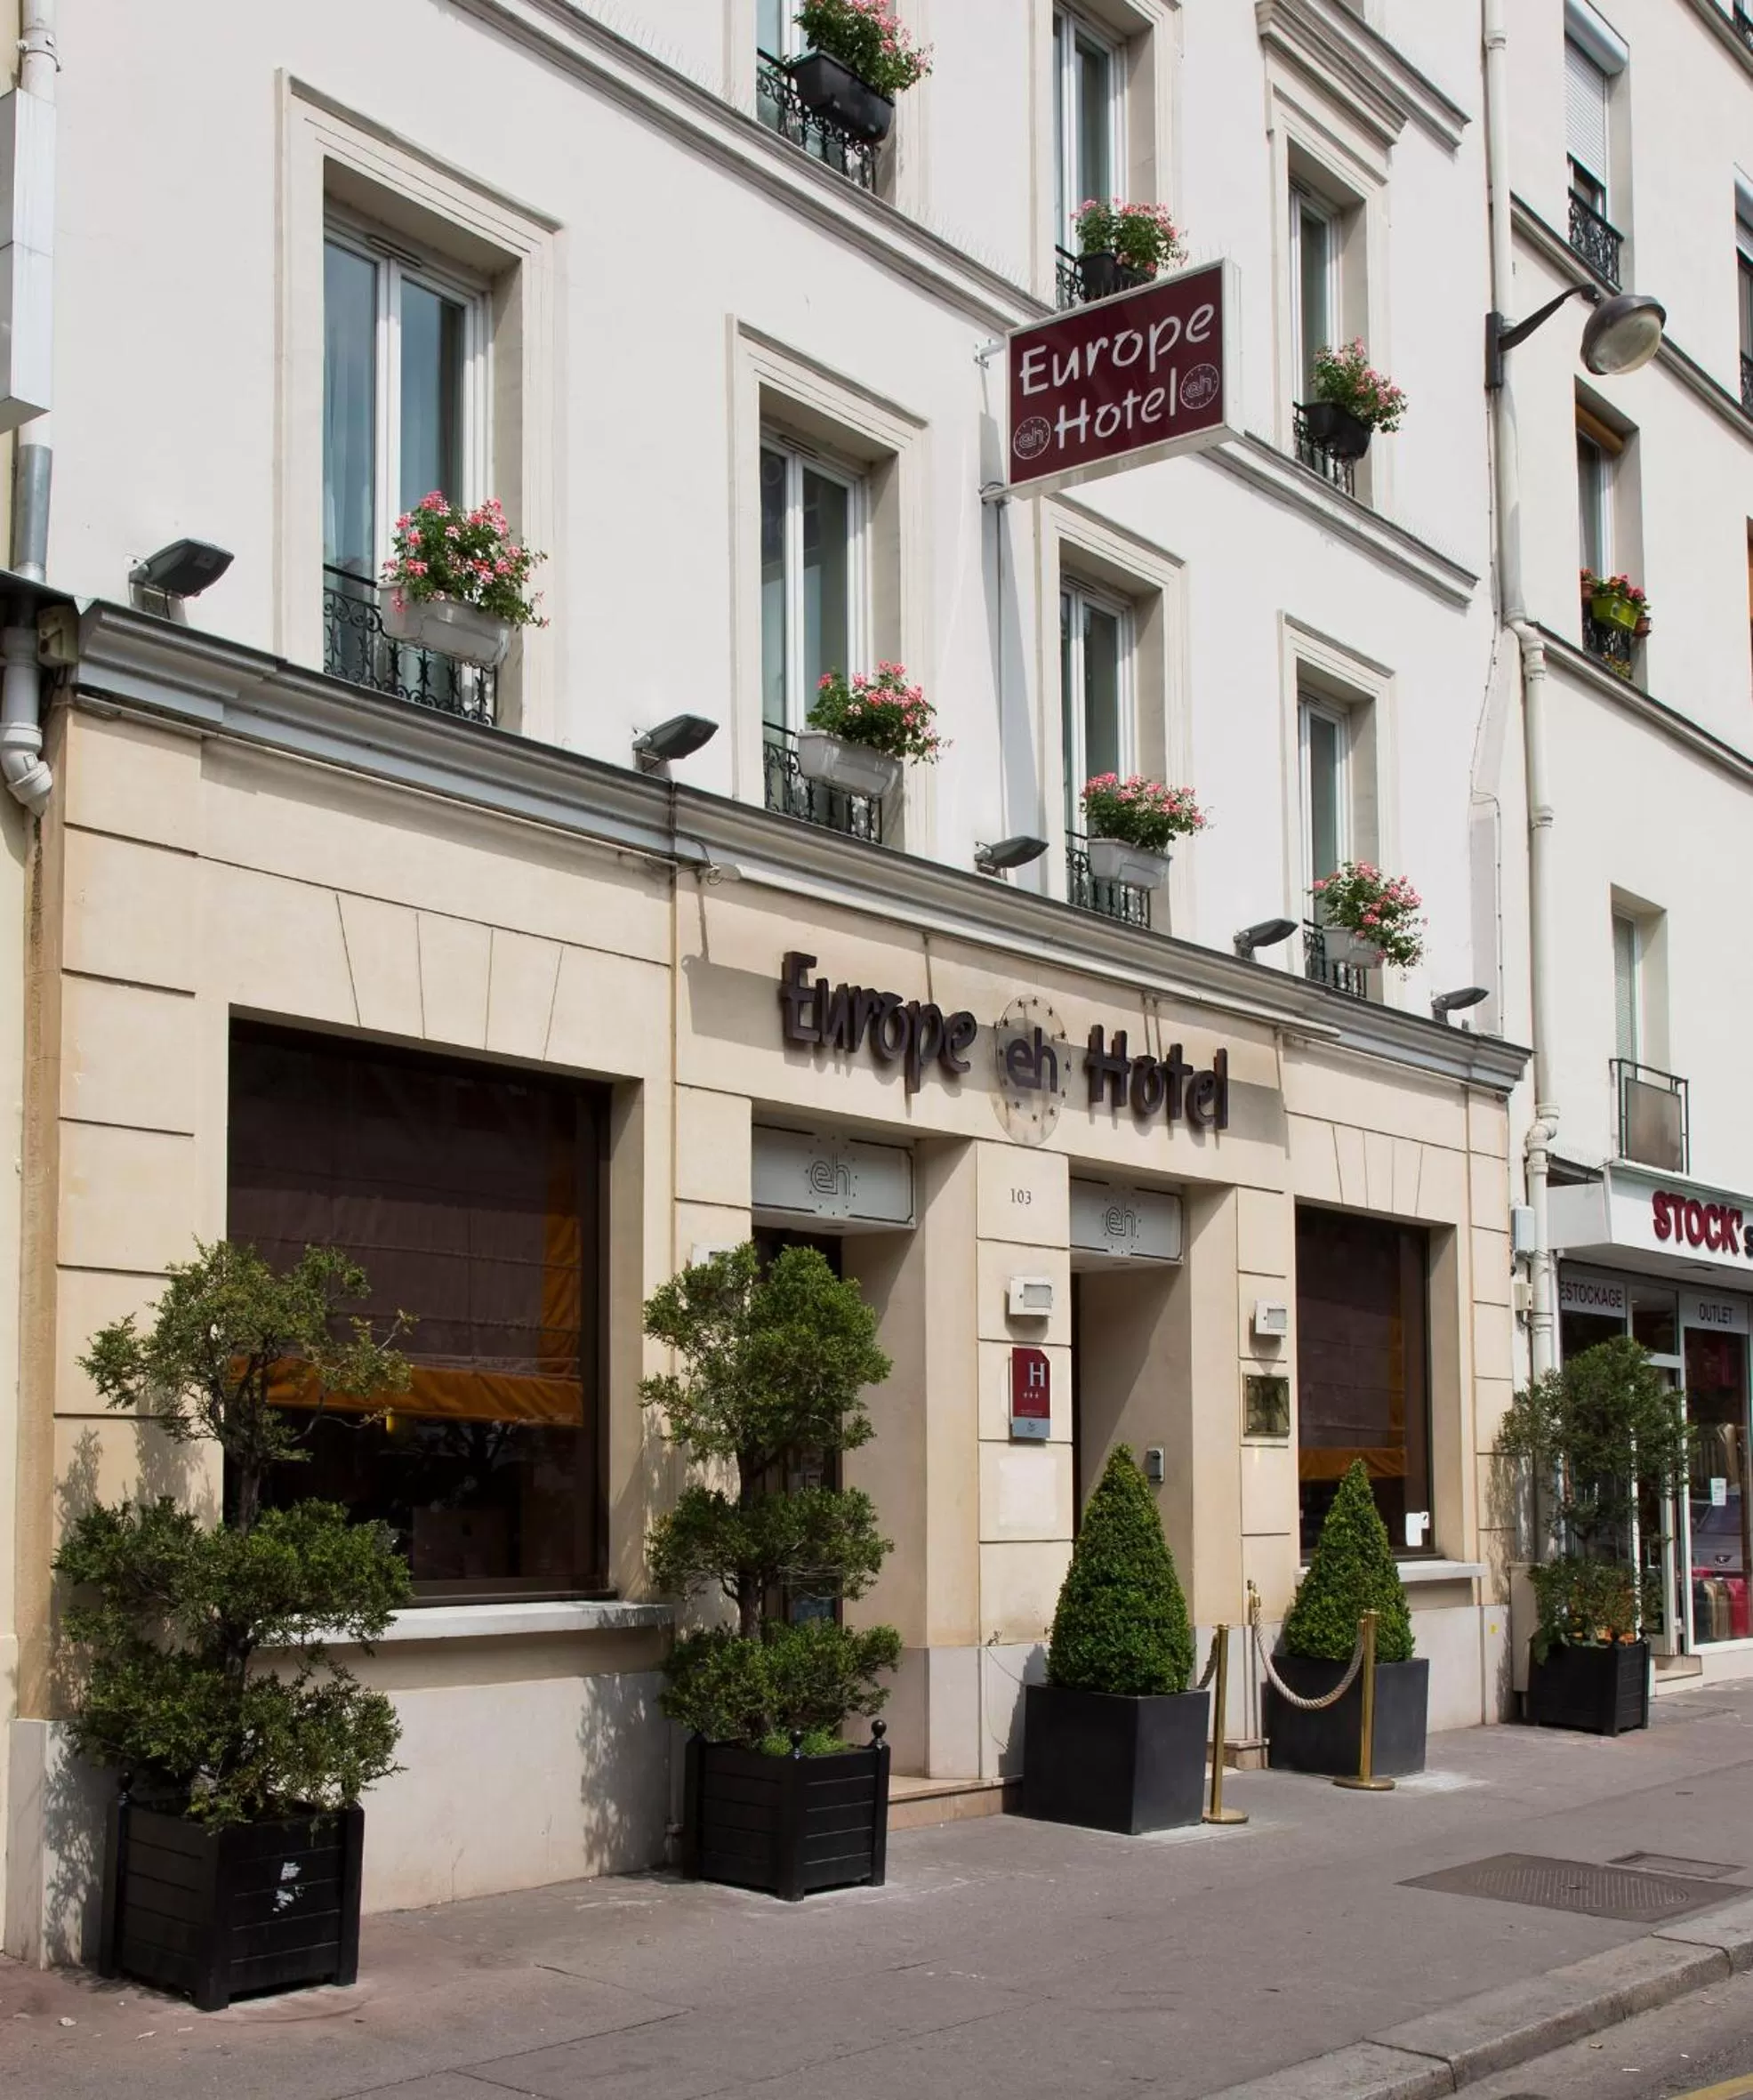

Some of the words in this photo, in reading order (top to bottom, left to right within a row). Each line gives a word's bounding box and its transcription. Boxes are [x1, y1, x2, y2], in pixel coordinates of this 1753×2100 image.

[1019, 303, 1215, 396] Europe
[1054, 366, 1177, 449] Hotel
[781, 951, 977, 1094] Europe
[1085, 1024, 1229, 1130] Hotel
[1009, 1187, 1032, 1205] 103
[1699, 1302, 1733, 1324] OUTLET
[1029, 1361, 1046, 1388] H
